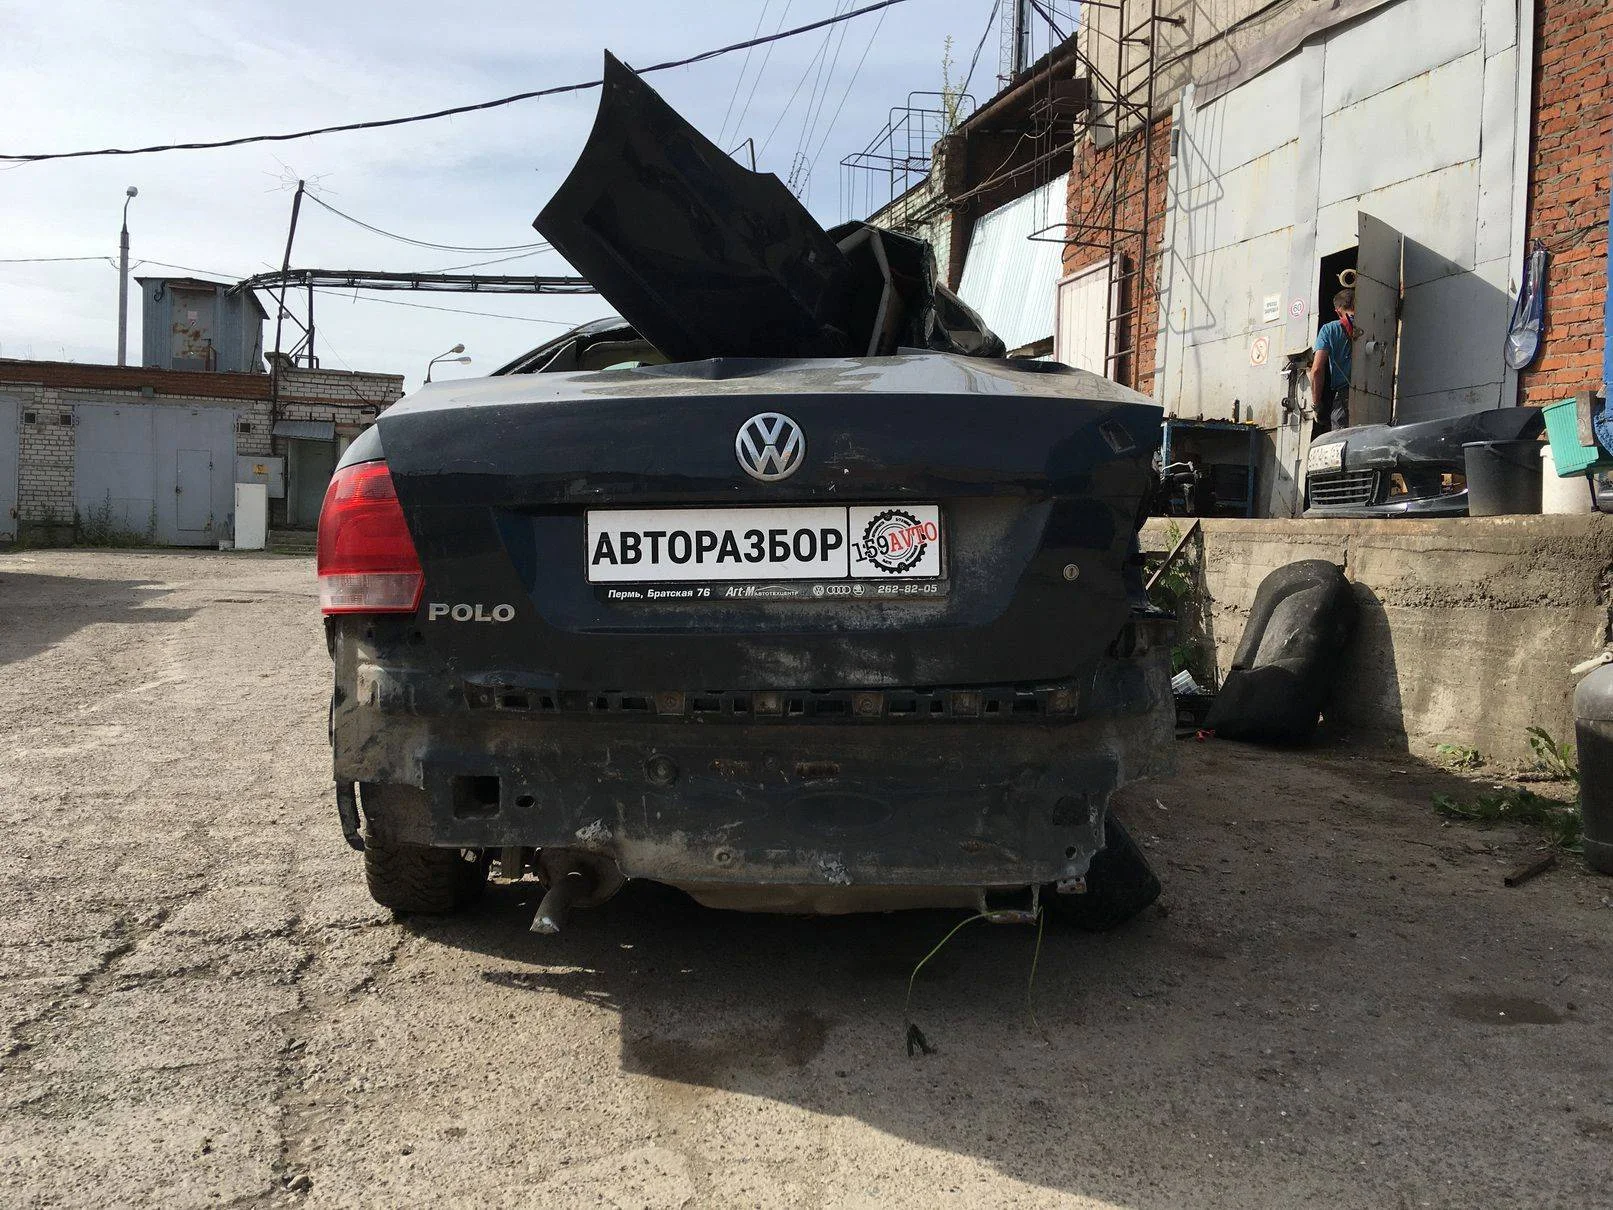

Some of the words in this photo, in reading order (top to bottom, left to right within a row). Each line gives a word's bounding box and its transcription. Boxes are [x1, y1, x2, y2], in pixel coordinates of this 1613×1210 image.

[592, 528, 843, 566] АВТОРАЗБОР
[608, 589, 644, 600] Пермь,
[647, 589, 693, 600] Братская
[697, 588, 711, 597] 76
[428, 603, 515, 622] POLO
